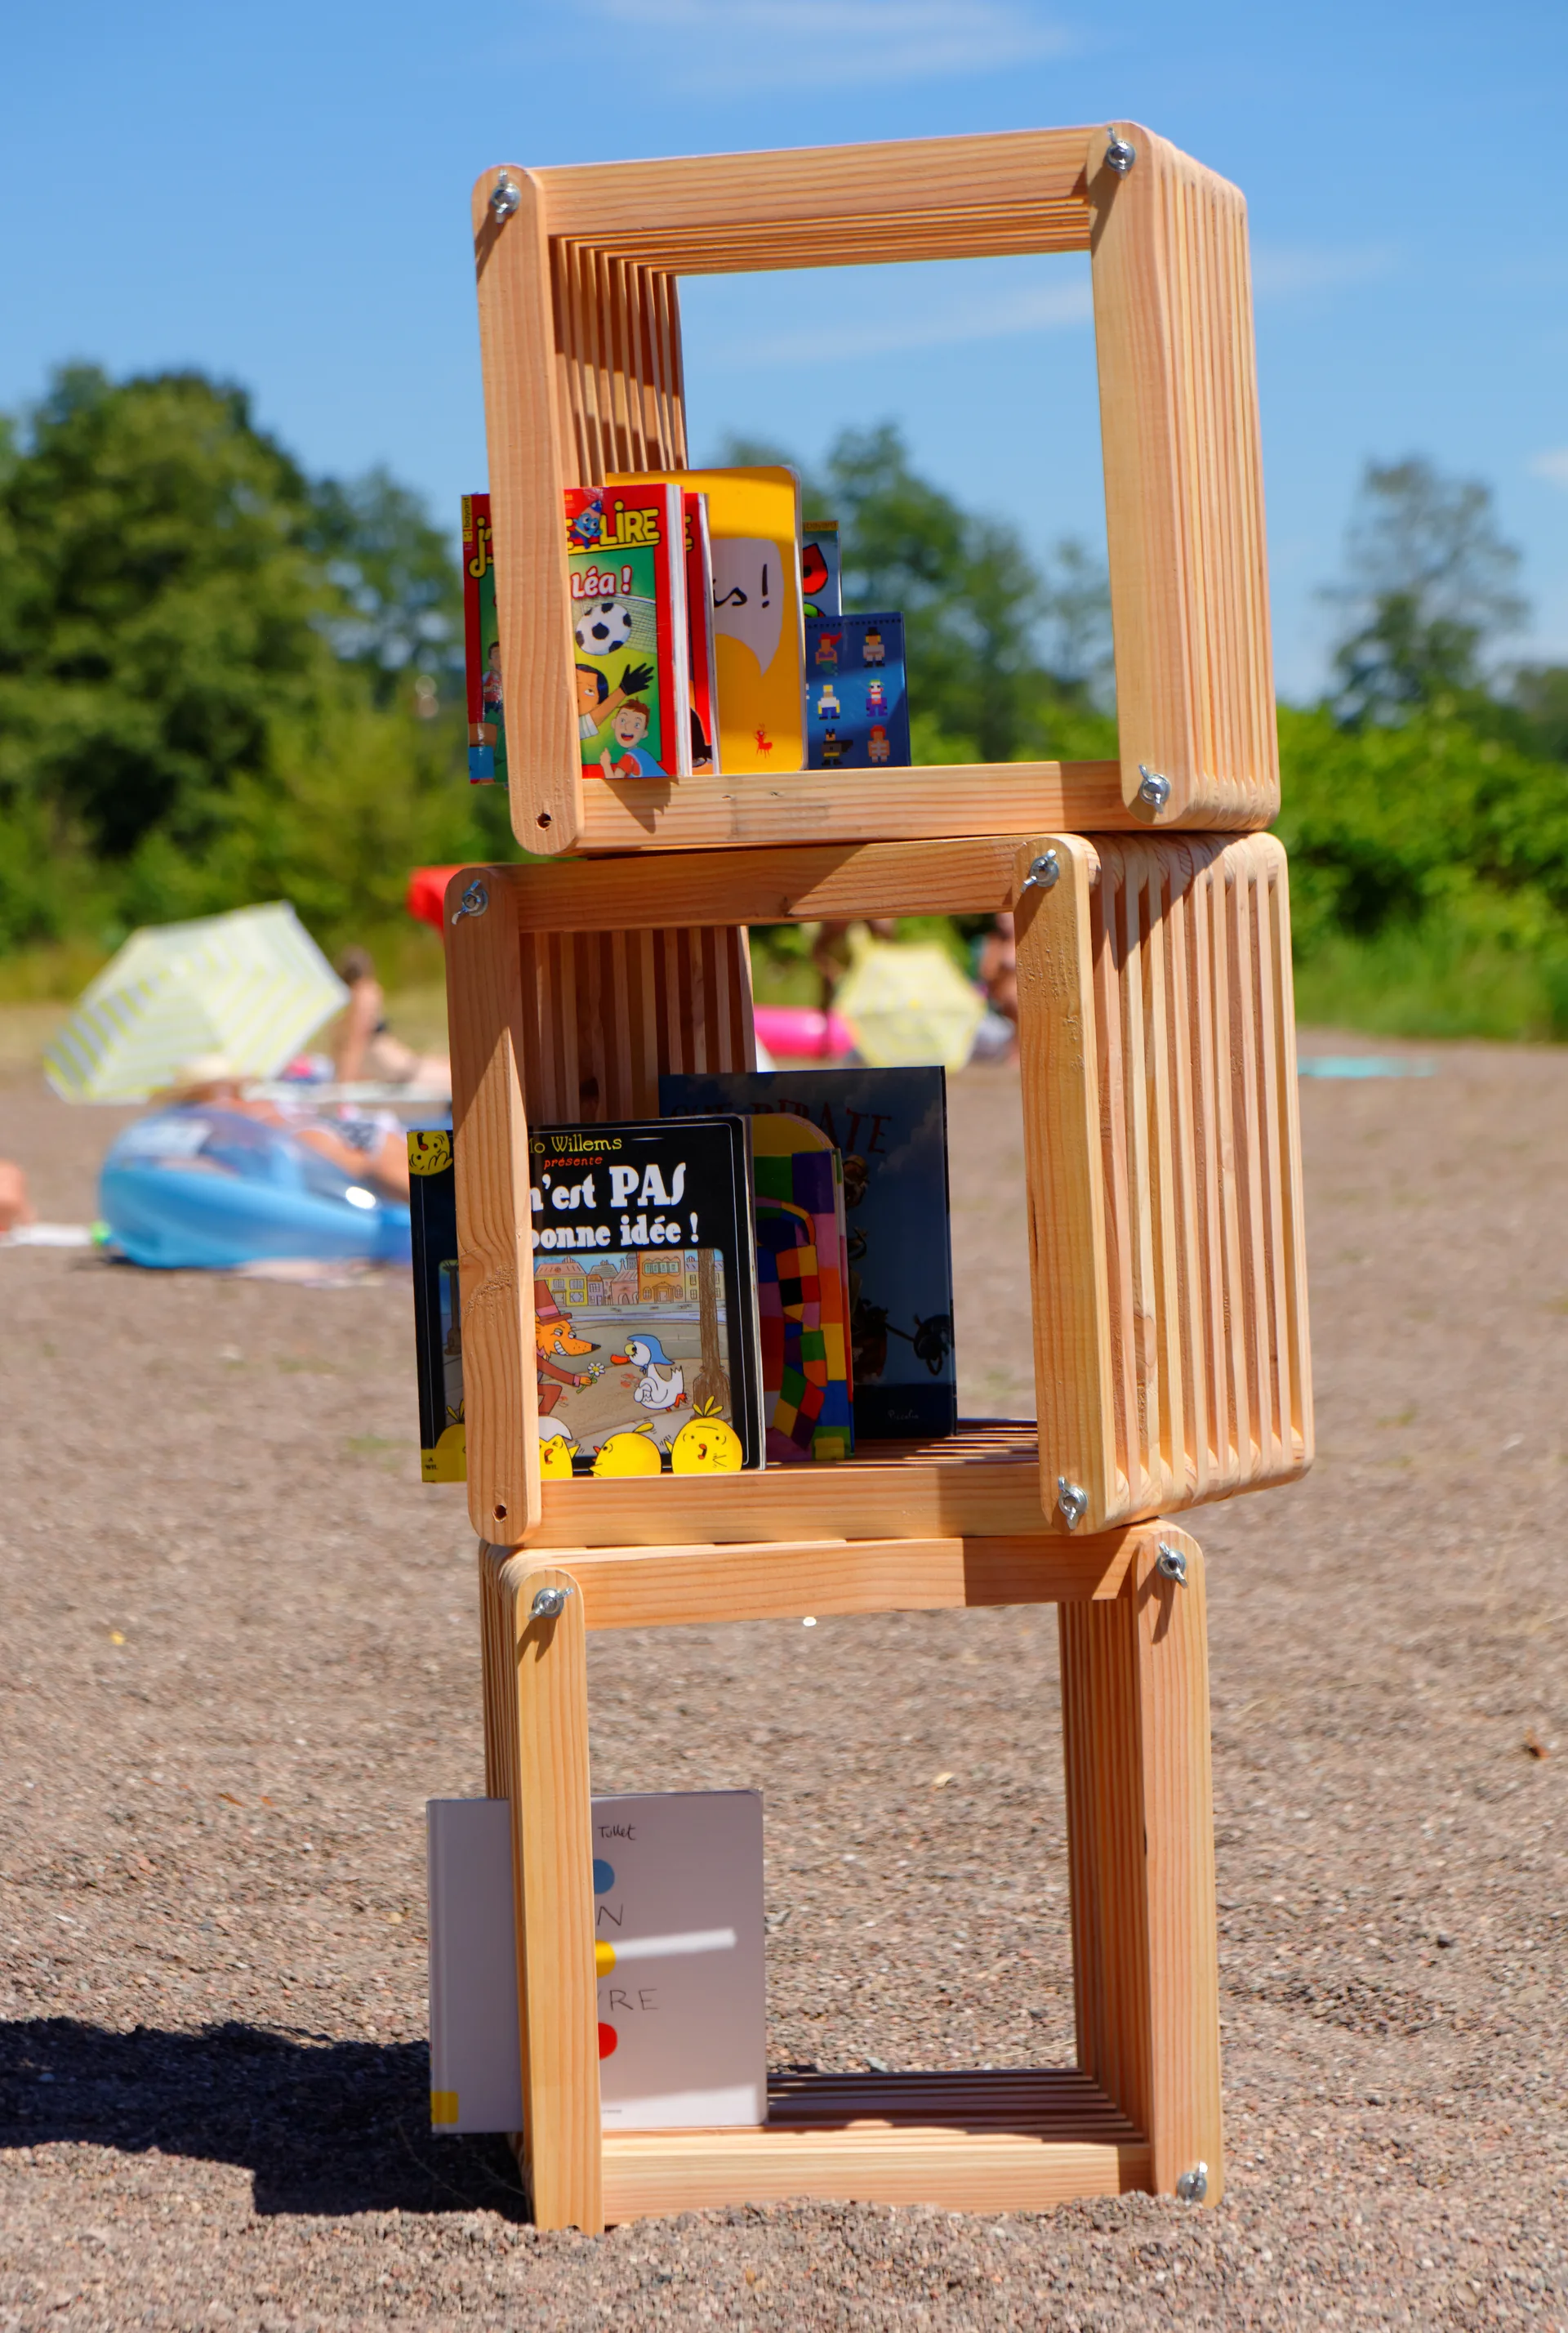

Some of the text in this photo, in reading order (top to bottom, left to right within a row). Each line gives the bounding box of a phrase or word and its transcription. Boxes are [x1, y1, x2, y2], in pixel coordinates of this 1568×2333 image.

[571, 565, 632, 599] Léa !
[551, 1134, 622, 1153] Willems
[543, 1156, 603, 1170] présente
[608, 1162, 686, 1207] PAS
[620, 1214, 682, 1247] idée
[598, 1823, 637, 1840] Tullet
